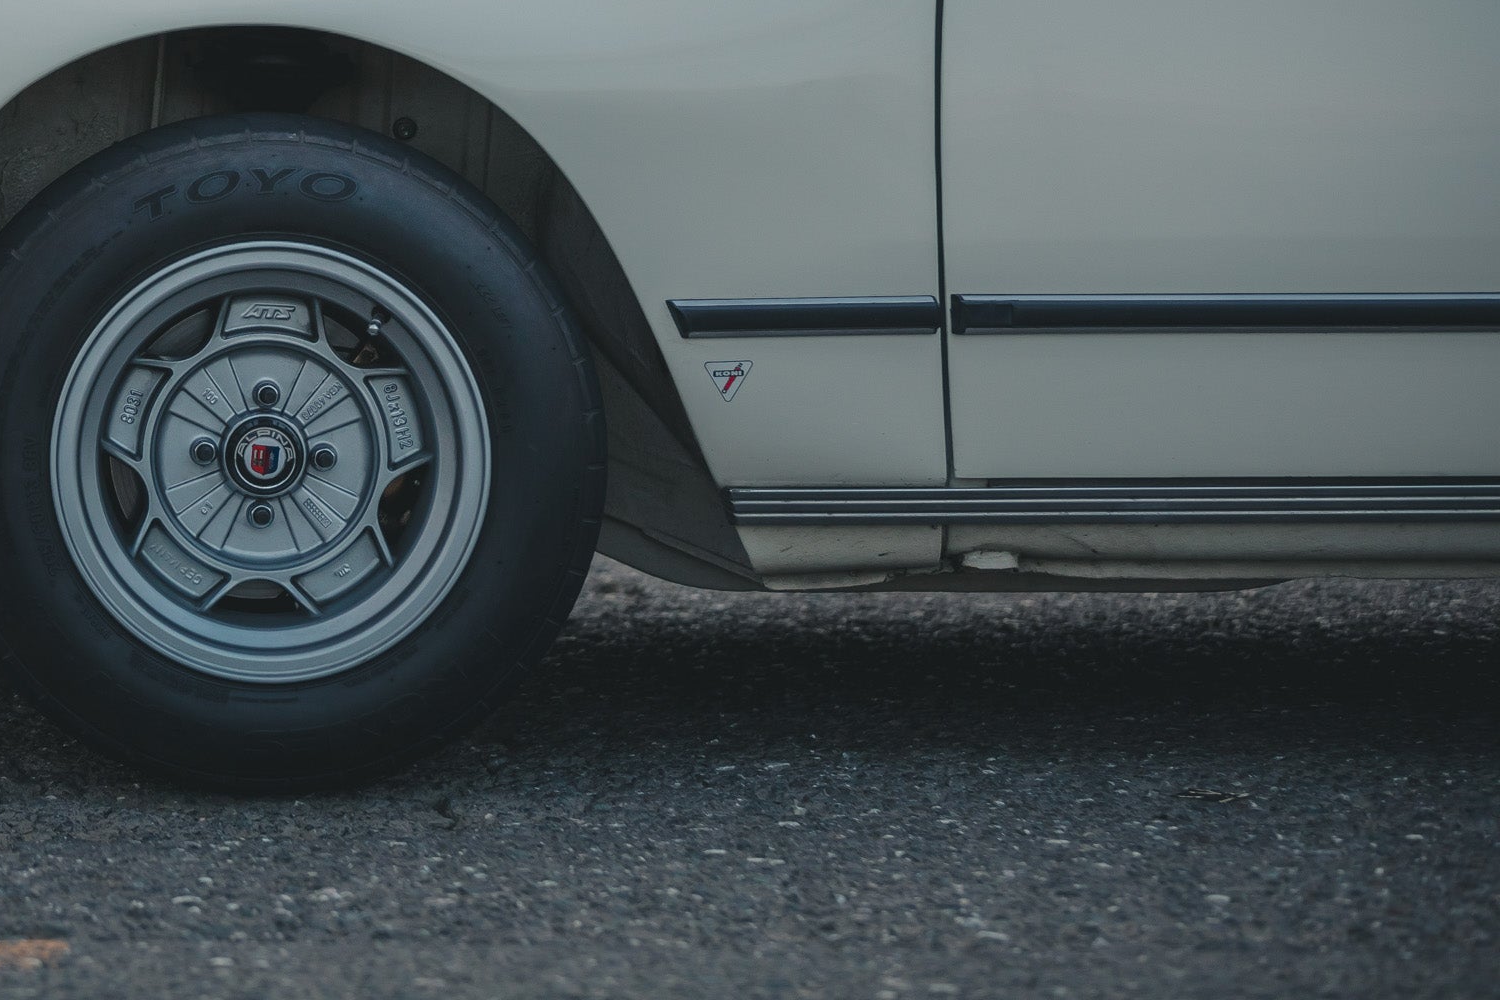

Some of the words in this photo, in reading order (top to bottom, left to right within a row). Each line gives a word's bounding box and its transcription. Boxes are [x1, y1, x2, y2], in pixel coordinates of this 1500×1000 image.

[132, 167, 357, 223] TOYO
[242, 303, 297, 320] ATS
[120, 389, 143, 424] 8031
[237, 429, 294, 462] ALPINA
